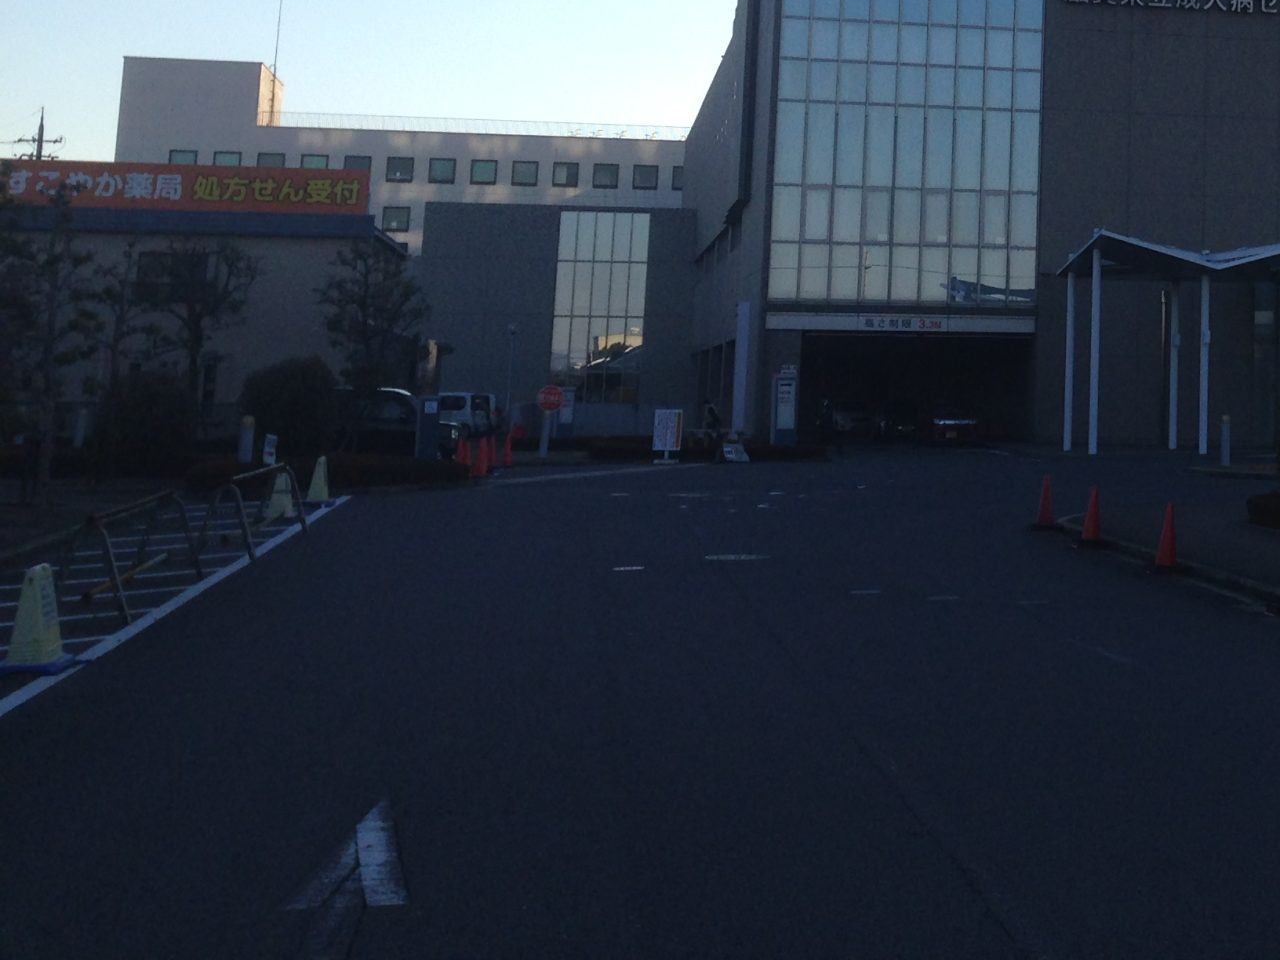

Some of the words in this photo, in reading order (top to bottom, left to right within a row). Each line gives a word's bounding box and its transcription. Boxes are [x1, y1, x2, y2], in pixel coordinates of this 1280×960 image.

[8, 169, 183, 201] すこやか薬局
[193, 174, 361, 205] 処方せん受付
